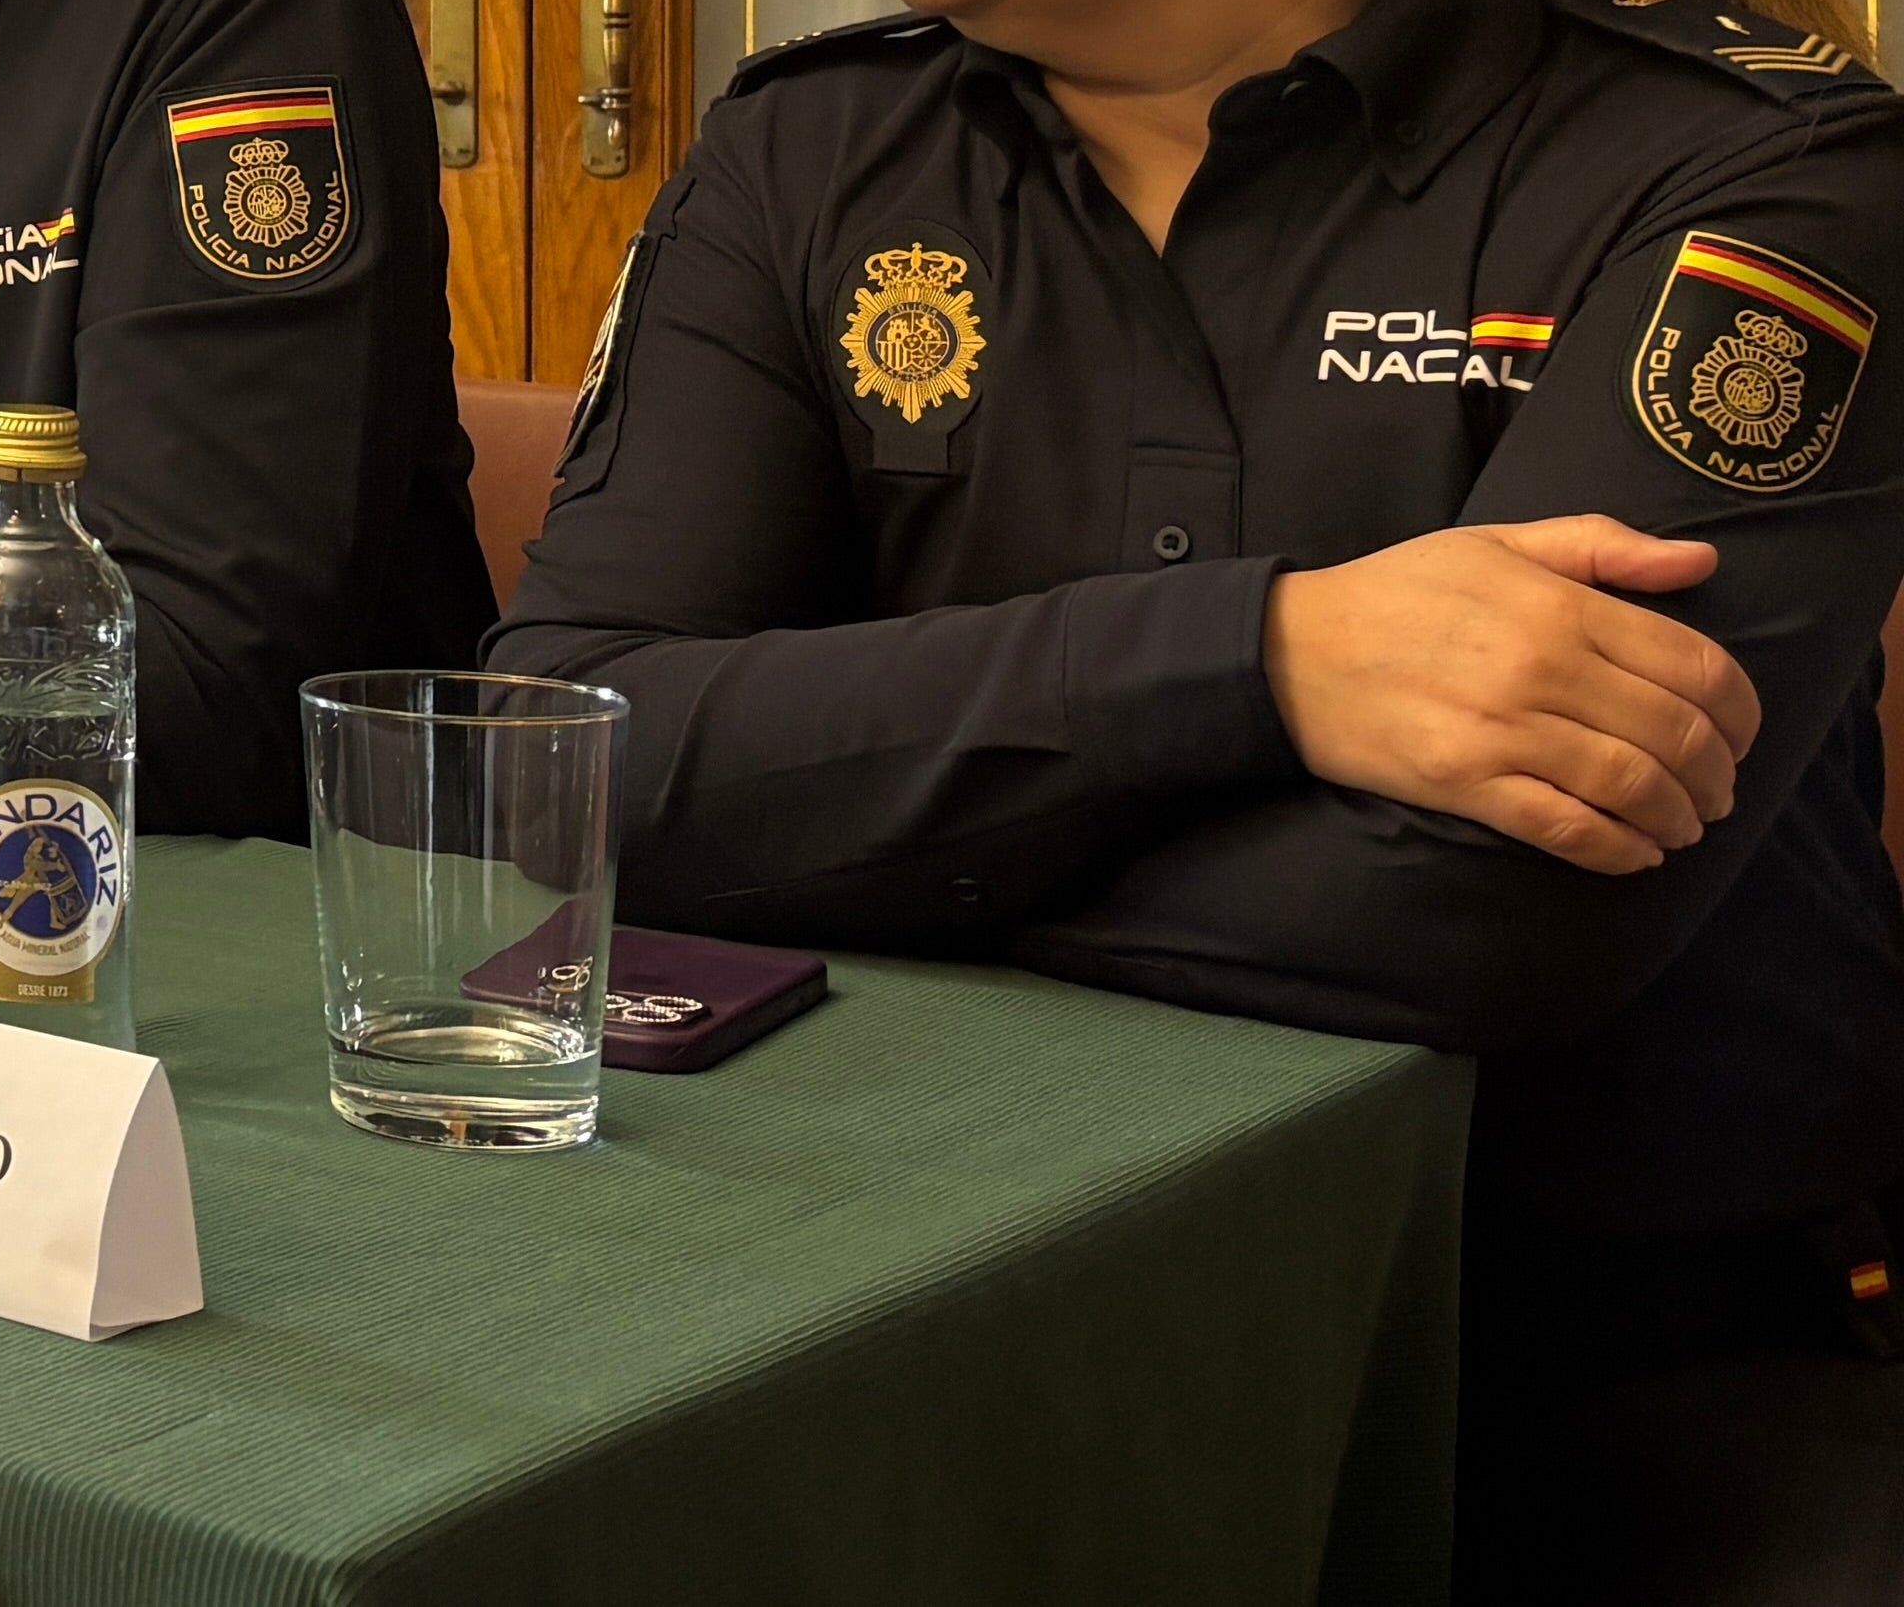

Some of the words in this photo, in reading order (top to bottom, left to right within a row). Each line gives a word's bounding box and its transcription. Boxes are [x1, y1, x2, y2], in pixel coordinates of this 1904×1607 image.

[189, 184, 250, 269] POLICIA
[266, 171, 342, 271] NACIONAL
[1648, 326, 1693, 450] POLICIA
[1707, 404, 1838, 482] NACIONAL
